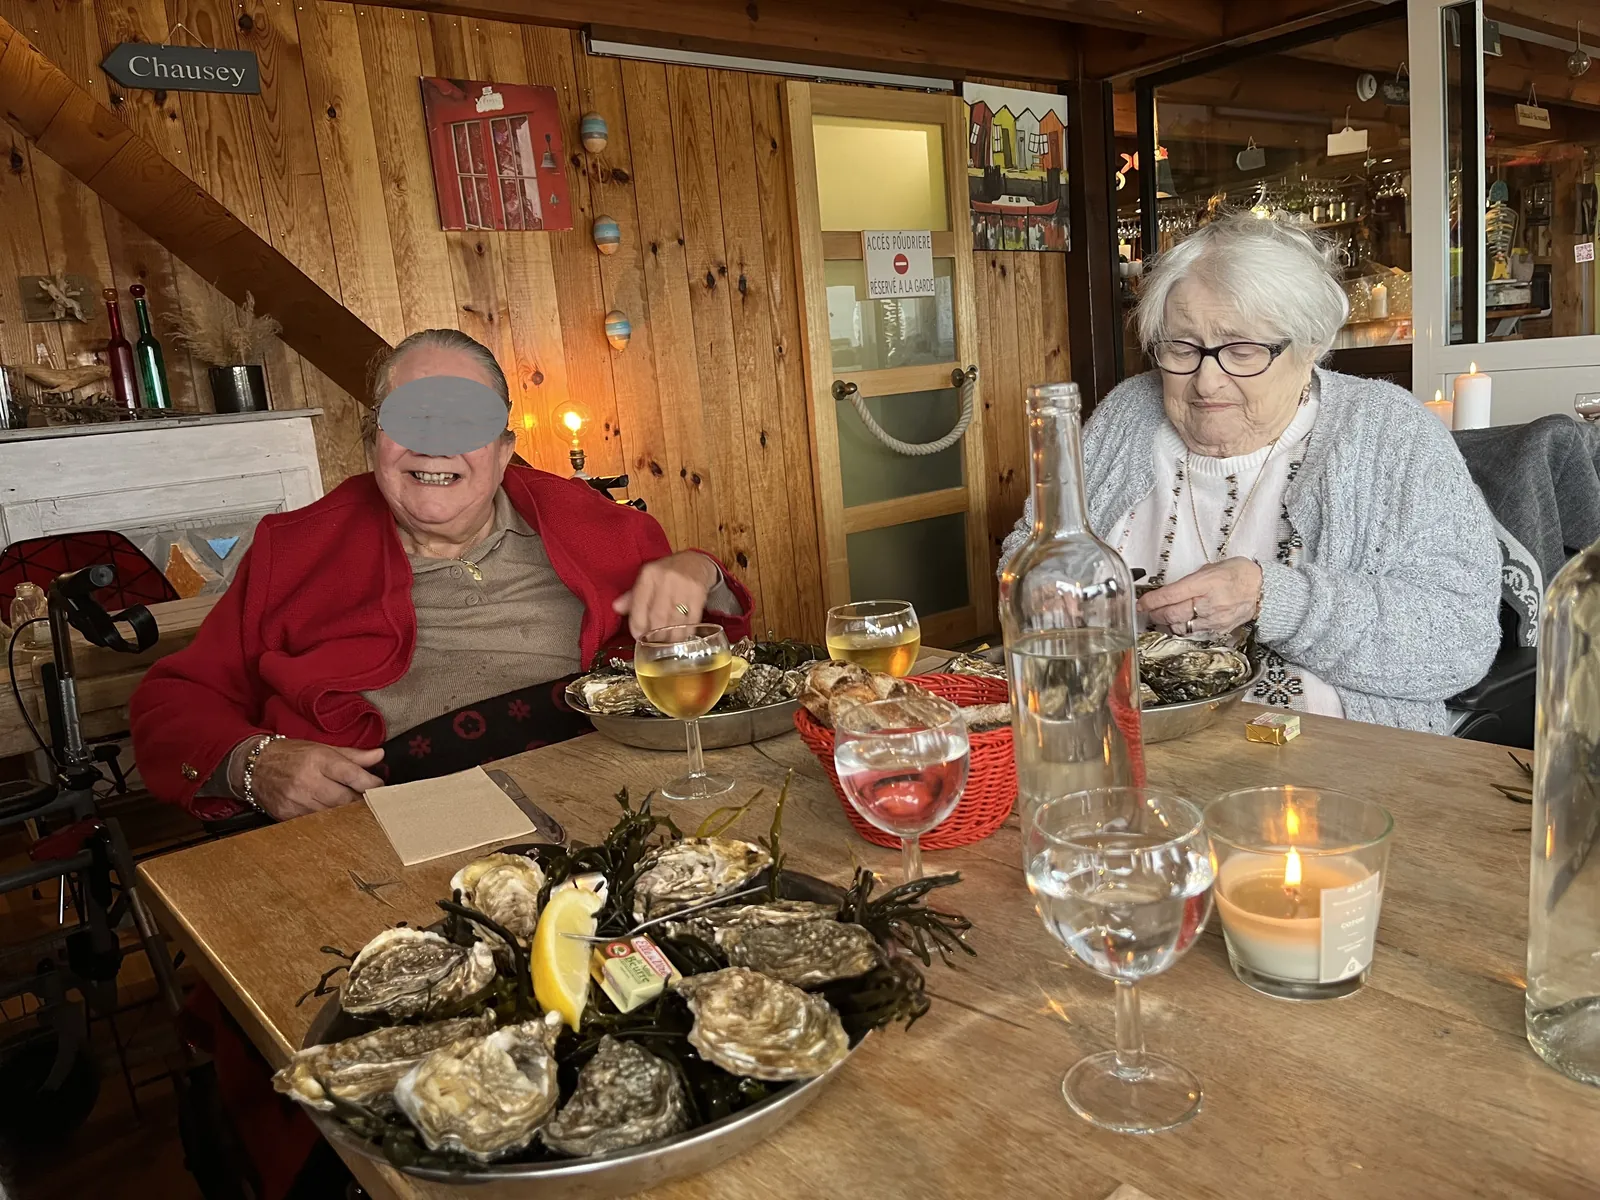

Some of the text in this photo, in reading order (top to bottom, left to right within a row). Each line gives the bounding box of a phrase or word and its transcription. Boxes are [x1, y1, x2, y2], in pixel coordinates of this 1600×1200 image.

[128, 56, 246, 87] Chausey
[870, 277, 897, 295] RÉSERVÉ
[905, 280, 913, 292] LA
[915, 279, 934, 292] GARDE
